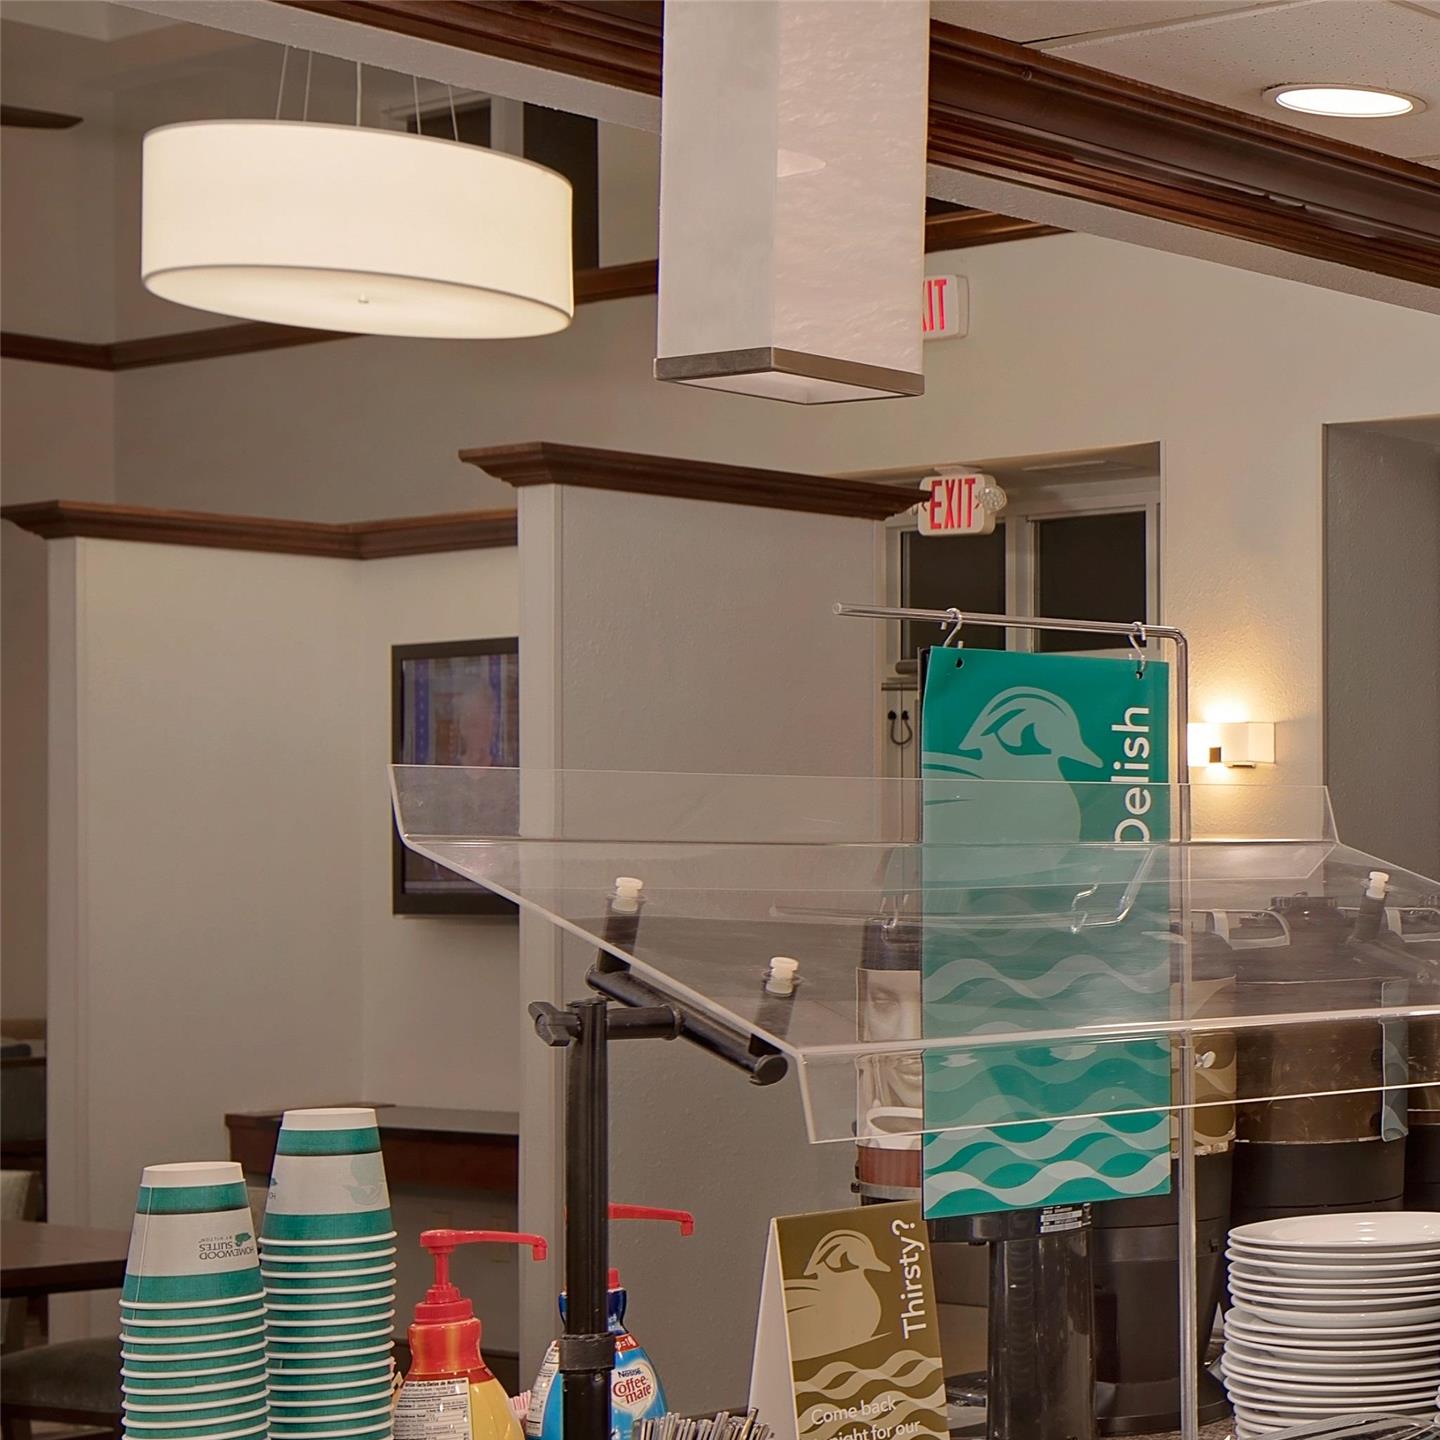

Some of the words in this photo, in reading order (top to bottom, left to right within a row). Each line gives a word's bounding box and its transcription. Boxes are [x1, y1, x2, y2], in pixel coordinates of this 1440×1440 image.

[923, 279, 947, 332] IT
[930, 477, 976, 530] EXIT
[1111, 707, 1152, 850] Delish
[199, 1241, 233, 1252] SUITES
[892, 1219, 927, 1340] Thirsty?
[625, 1384, 652, 1404] mate
[811, 1406, 858, 1425] Come
[860, 1395, 897, 1416] back
[870, 1424, 893, 1440] for
[895, 1420, 921, 1436] our
